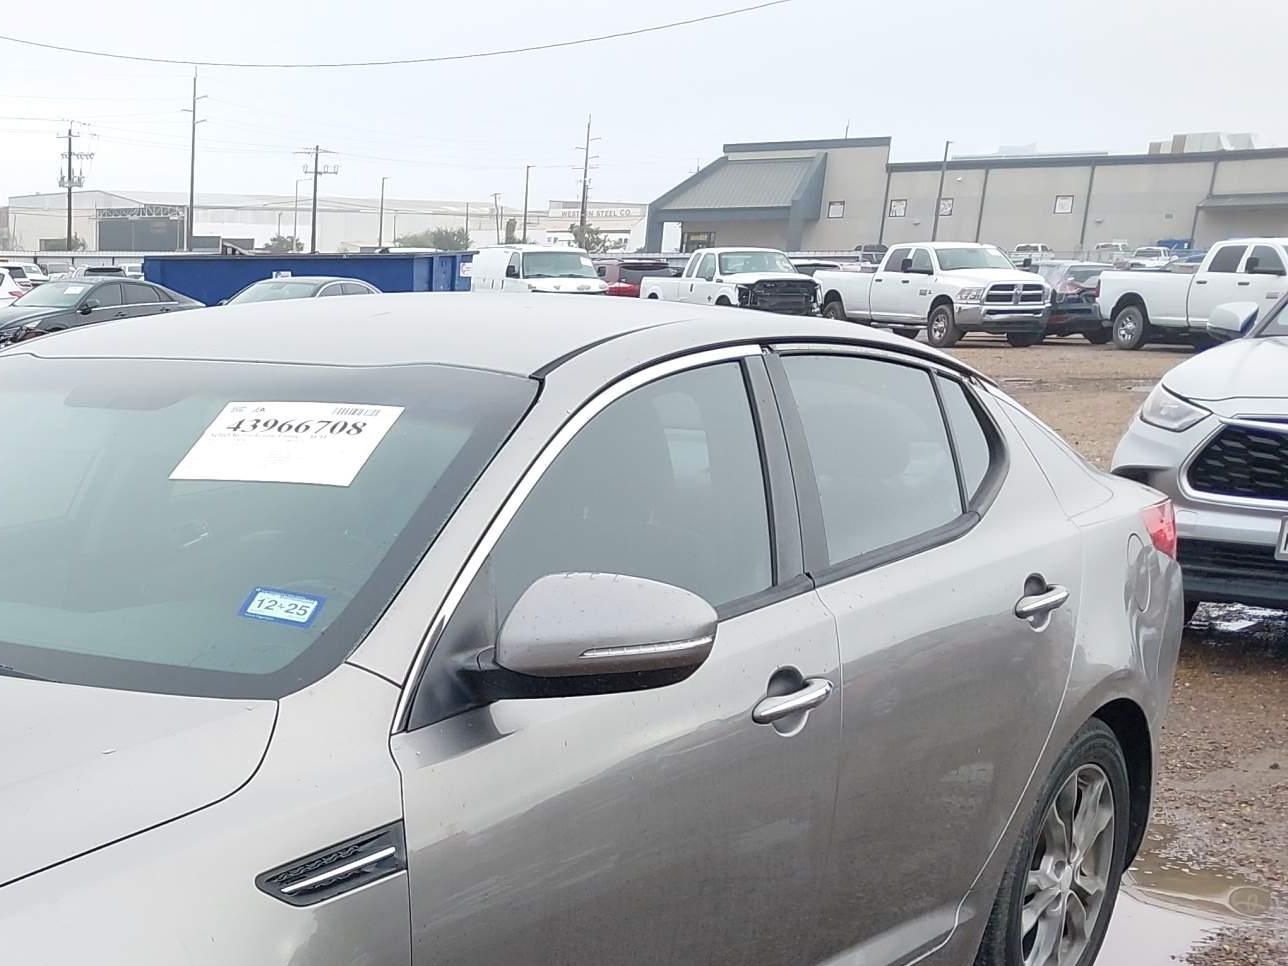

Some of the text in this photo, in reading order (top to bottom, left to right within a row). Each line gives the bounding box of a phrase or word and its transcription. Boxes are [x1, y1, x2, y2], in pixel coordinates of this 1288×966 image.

[226, 418, 367, 436] 43966708
[257, 598, 278, 611] 12
[284, 603, 311, 616] 25
